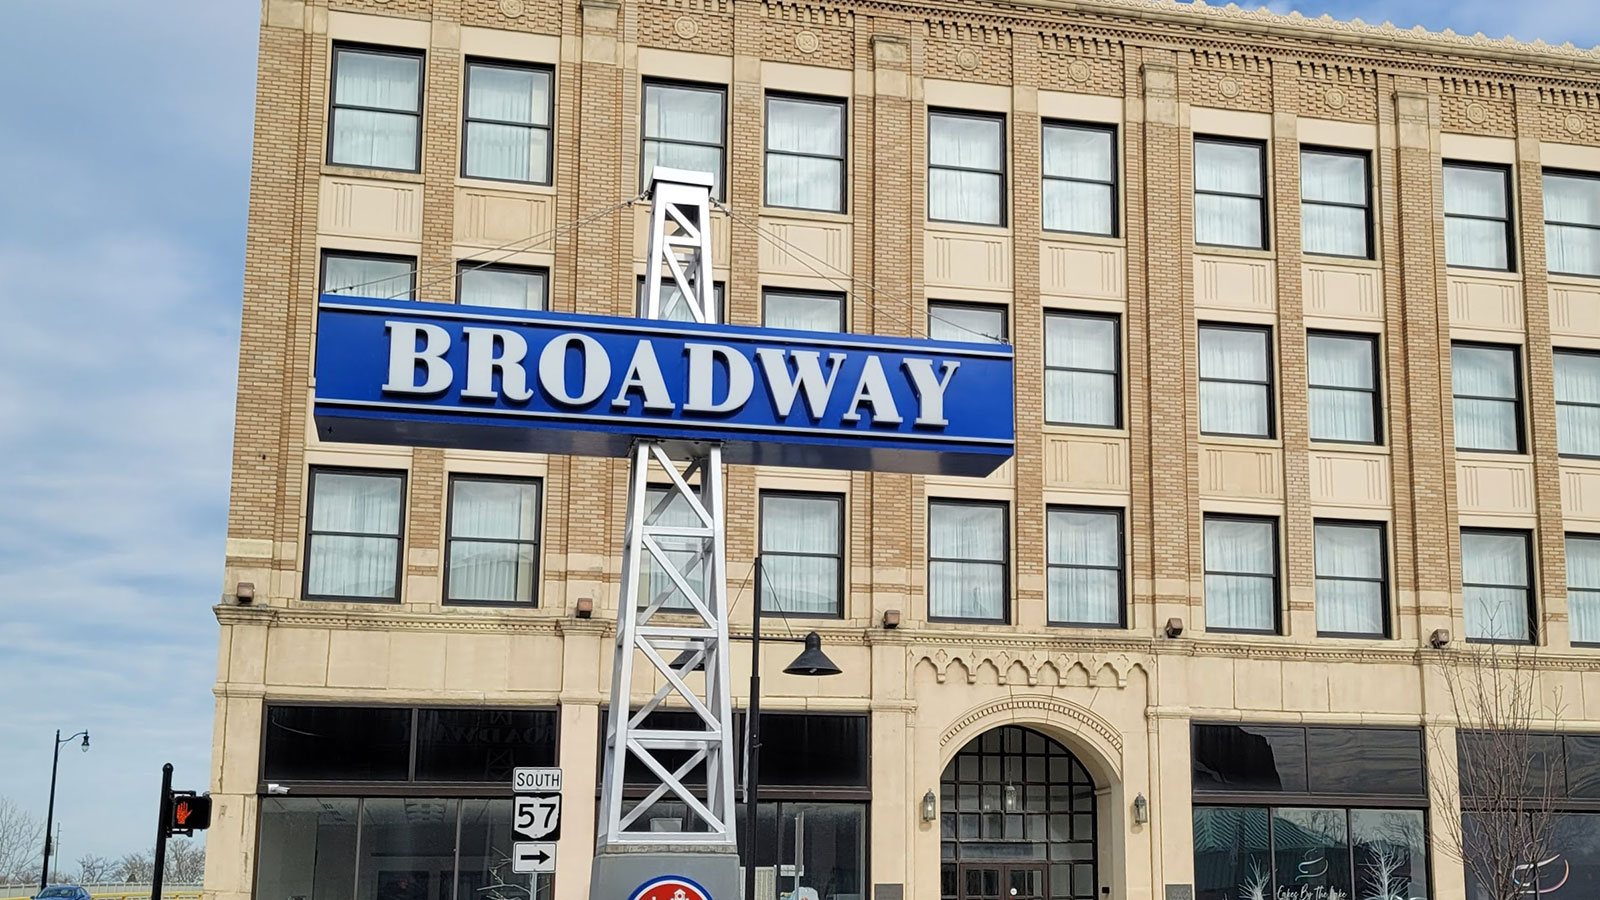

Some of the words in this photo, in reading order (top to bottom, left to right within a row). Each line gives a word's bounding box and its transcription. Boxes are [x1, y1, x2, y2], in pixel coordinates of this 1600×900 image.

[382, 320, 961, 427] BROADWAY
[517, 772, 560, 787] SOUTH
[517, 803, 557, 829] 57
[1277, 884, 1299, 900] Cakes
[1299, 883, 1313, 900] By
[1314, 885, 1328, 900] The
